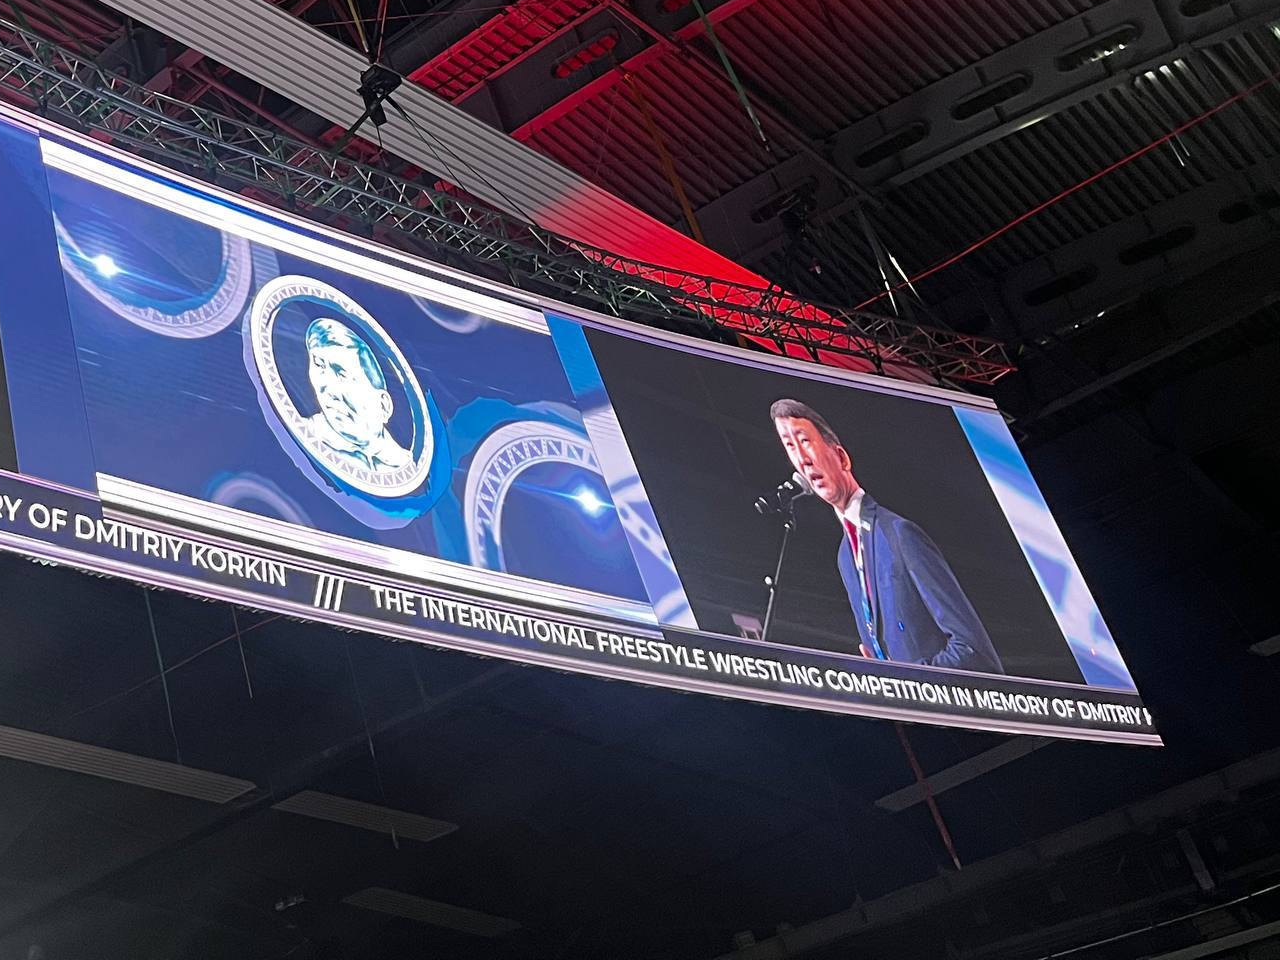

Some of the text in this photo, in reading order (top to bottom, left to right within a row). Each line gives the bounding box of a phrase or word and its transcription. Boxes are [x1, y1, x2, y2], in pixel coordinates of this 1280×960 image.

[28, 503, 68, 532] OF
[74, 513, 187, 562] DMITRIY
[191, 543, 287, 588] KORKIN
[370, 585, 417, 615] THE
[420, 595, 594, 651] INTERNATIONAL
[596, 632, 708, 671] FREESTYLE
[708, 651, 822, 688] WRESTLING
[825, 669, 951, 706] COMPETITION
[952, 686, 974, 707] IN
[976, 688, 1049, 716] MEMORY
[1051, 698, 1075, 718] OF
[1077, 700, 1141, 725] DMITRIY
